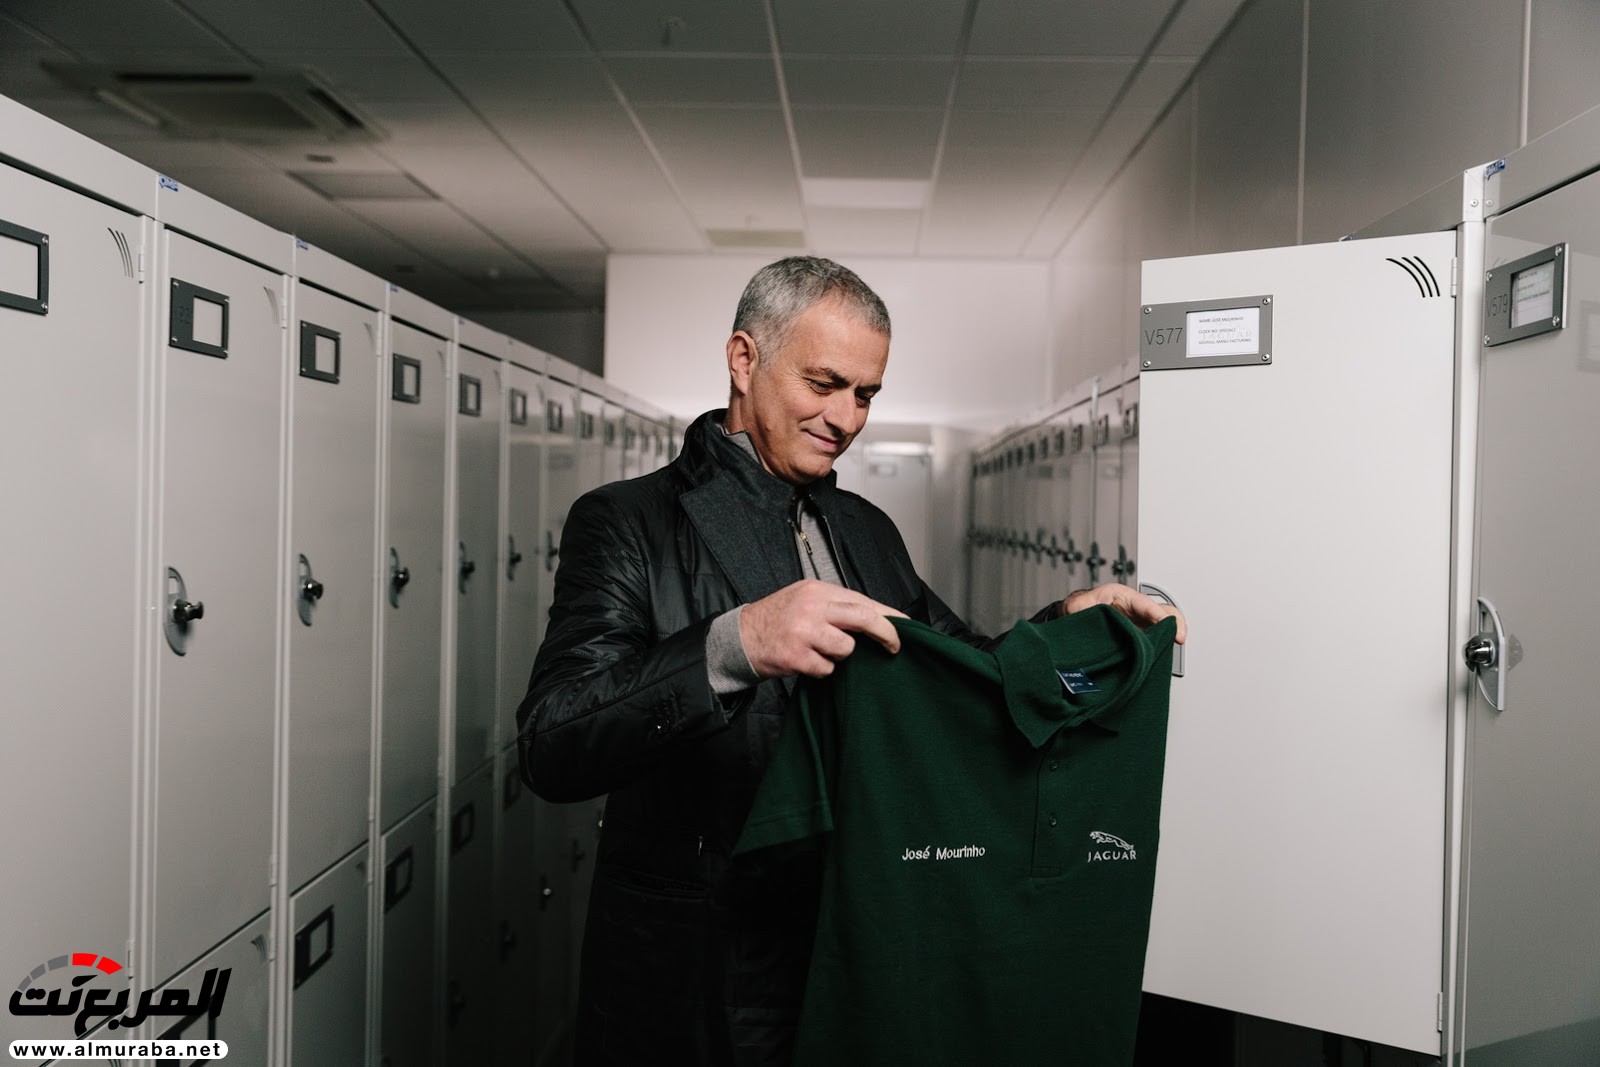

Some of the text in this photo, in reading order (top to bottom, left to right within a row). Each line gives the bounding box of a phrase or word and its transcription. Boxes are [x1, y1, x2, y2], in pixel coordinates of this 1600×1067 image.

[1486, 293, 1508, 317] V579
[1144, 327, 1183, 345] V577
[902, 844, 986, 861] José Mourinho
[1087, 850, 1137, 863] JAGUAR
